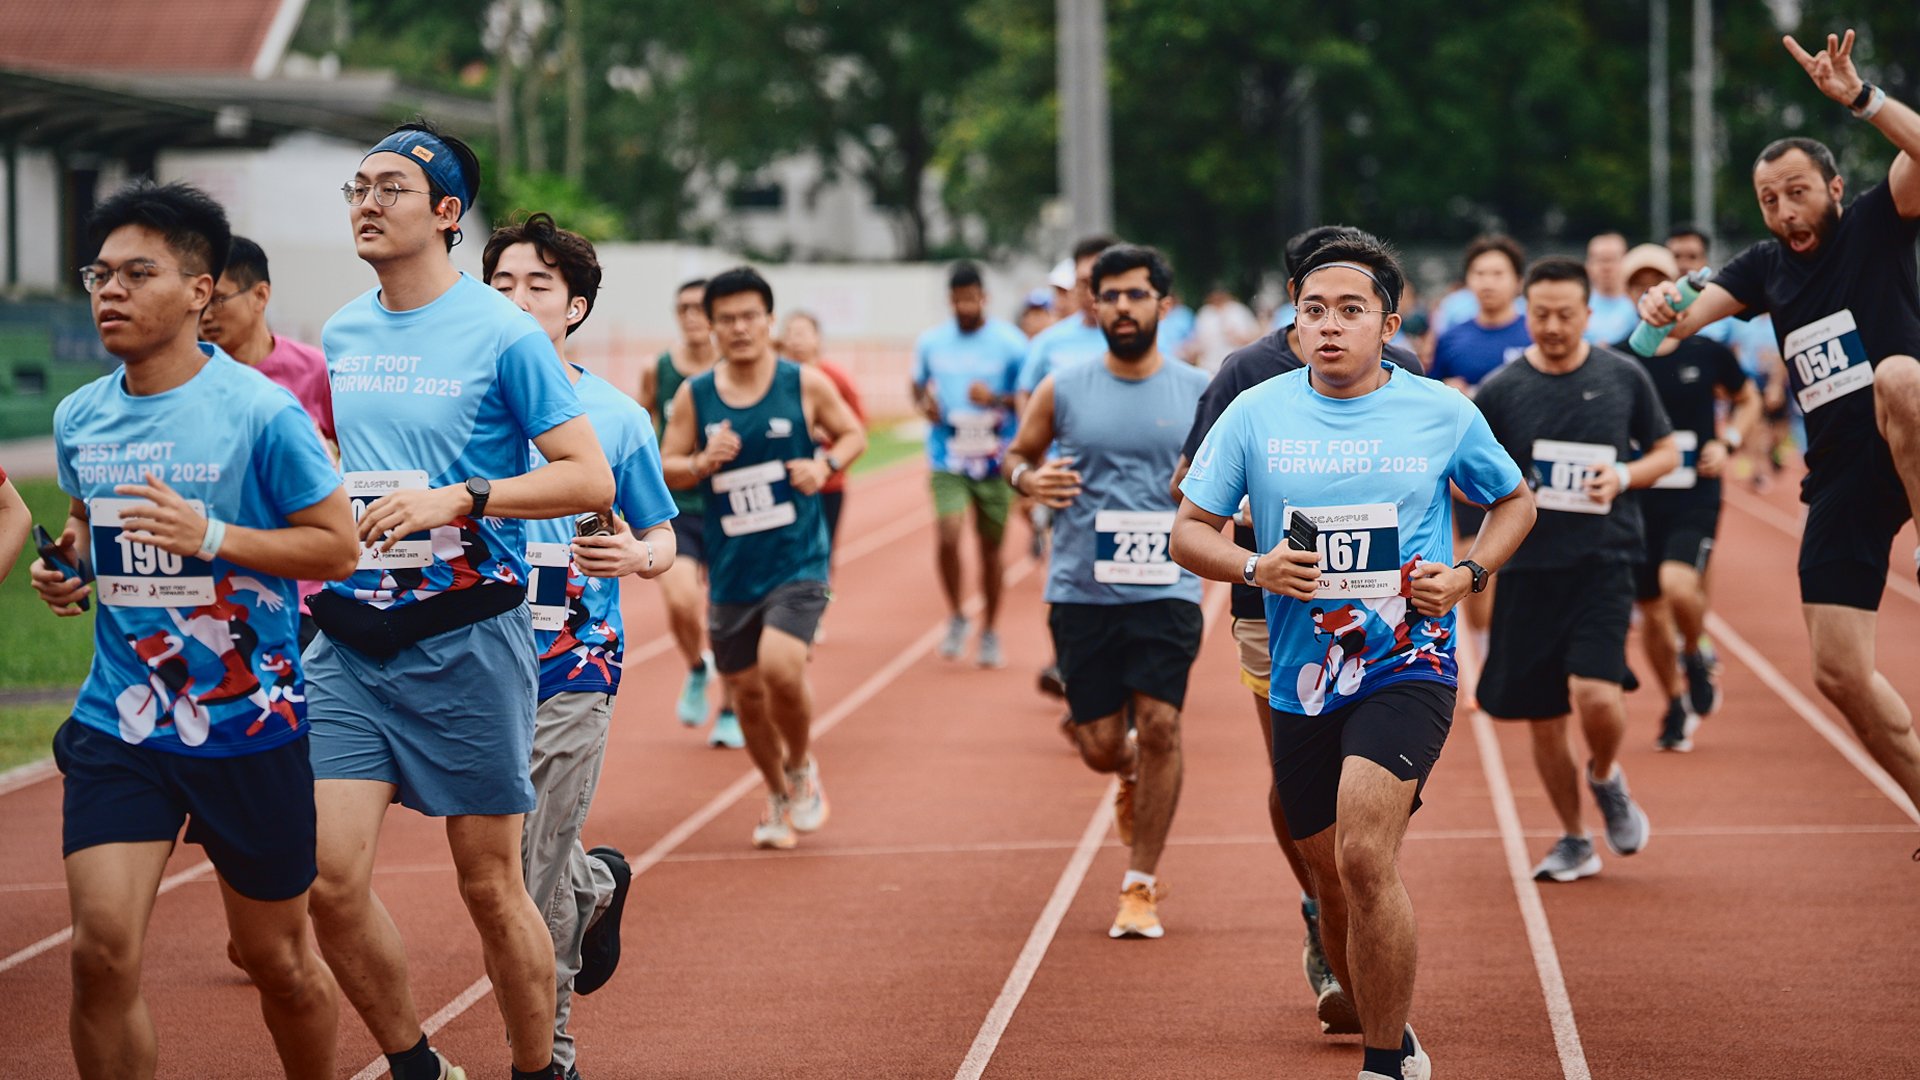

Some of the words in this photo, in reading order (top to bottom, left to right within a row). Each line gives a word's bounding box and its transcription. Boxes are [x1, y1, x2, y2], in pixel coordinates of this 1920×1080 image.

[374, 355, 421, 373] FOOT
[1795, 338, 1849, 386] 054
[333, 375, 408, 393] FORWARD
[413, 378, 462, 397] 2025
[77, 443, 120, 463] BEST
[125, 442, 175, 461] FOOT
[1267, 438, 1321, 455] BEST
[1328, 439, 1383, 455] FOOT
[77, 464, 164, 484] FORWARD
[171, 463, 221, 483] 2025
[1267, 457, 1372, 474] FORWARD
[1379, 457, 1428, 473] 2025
[1113, 533, 1168, 562] 232
[120, 584, 139, 593] NTU
